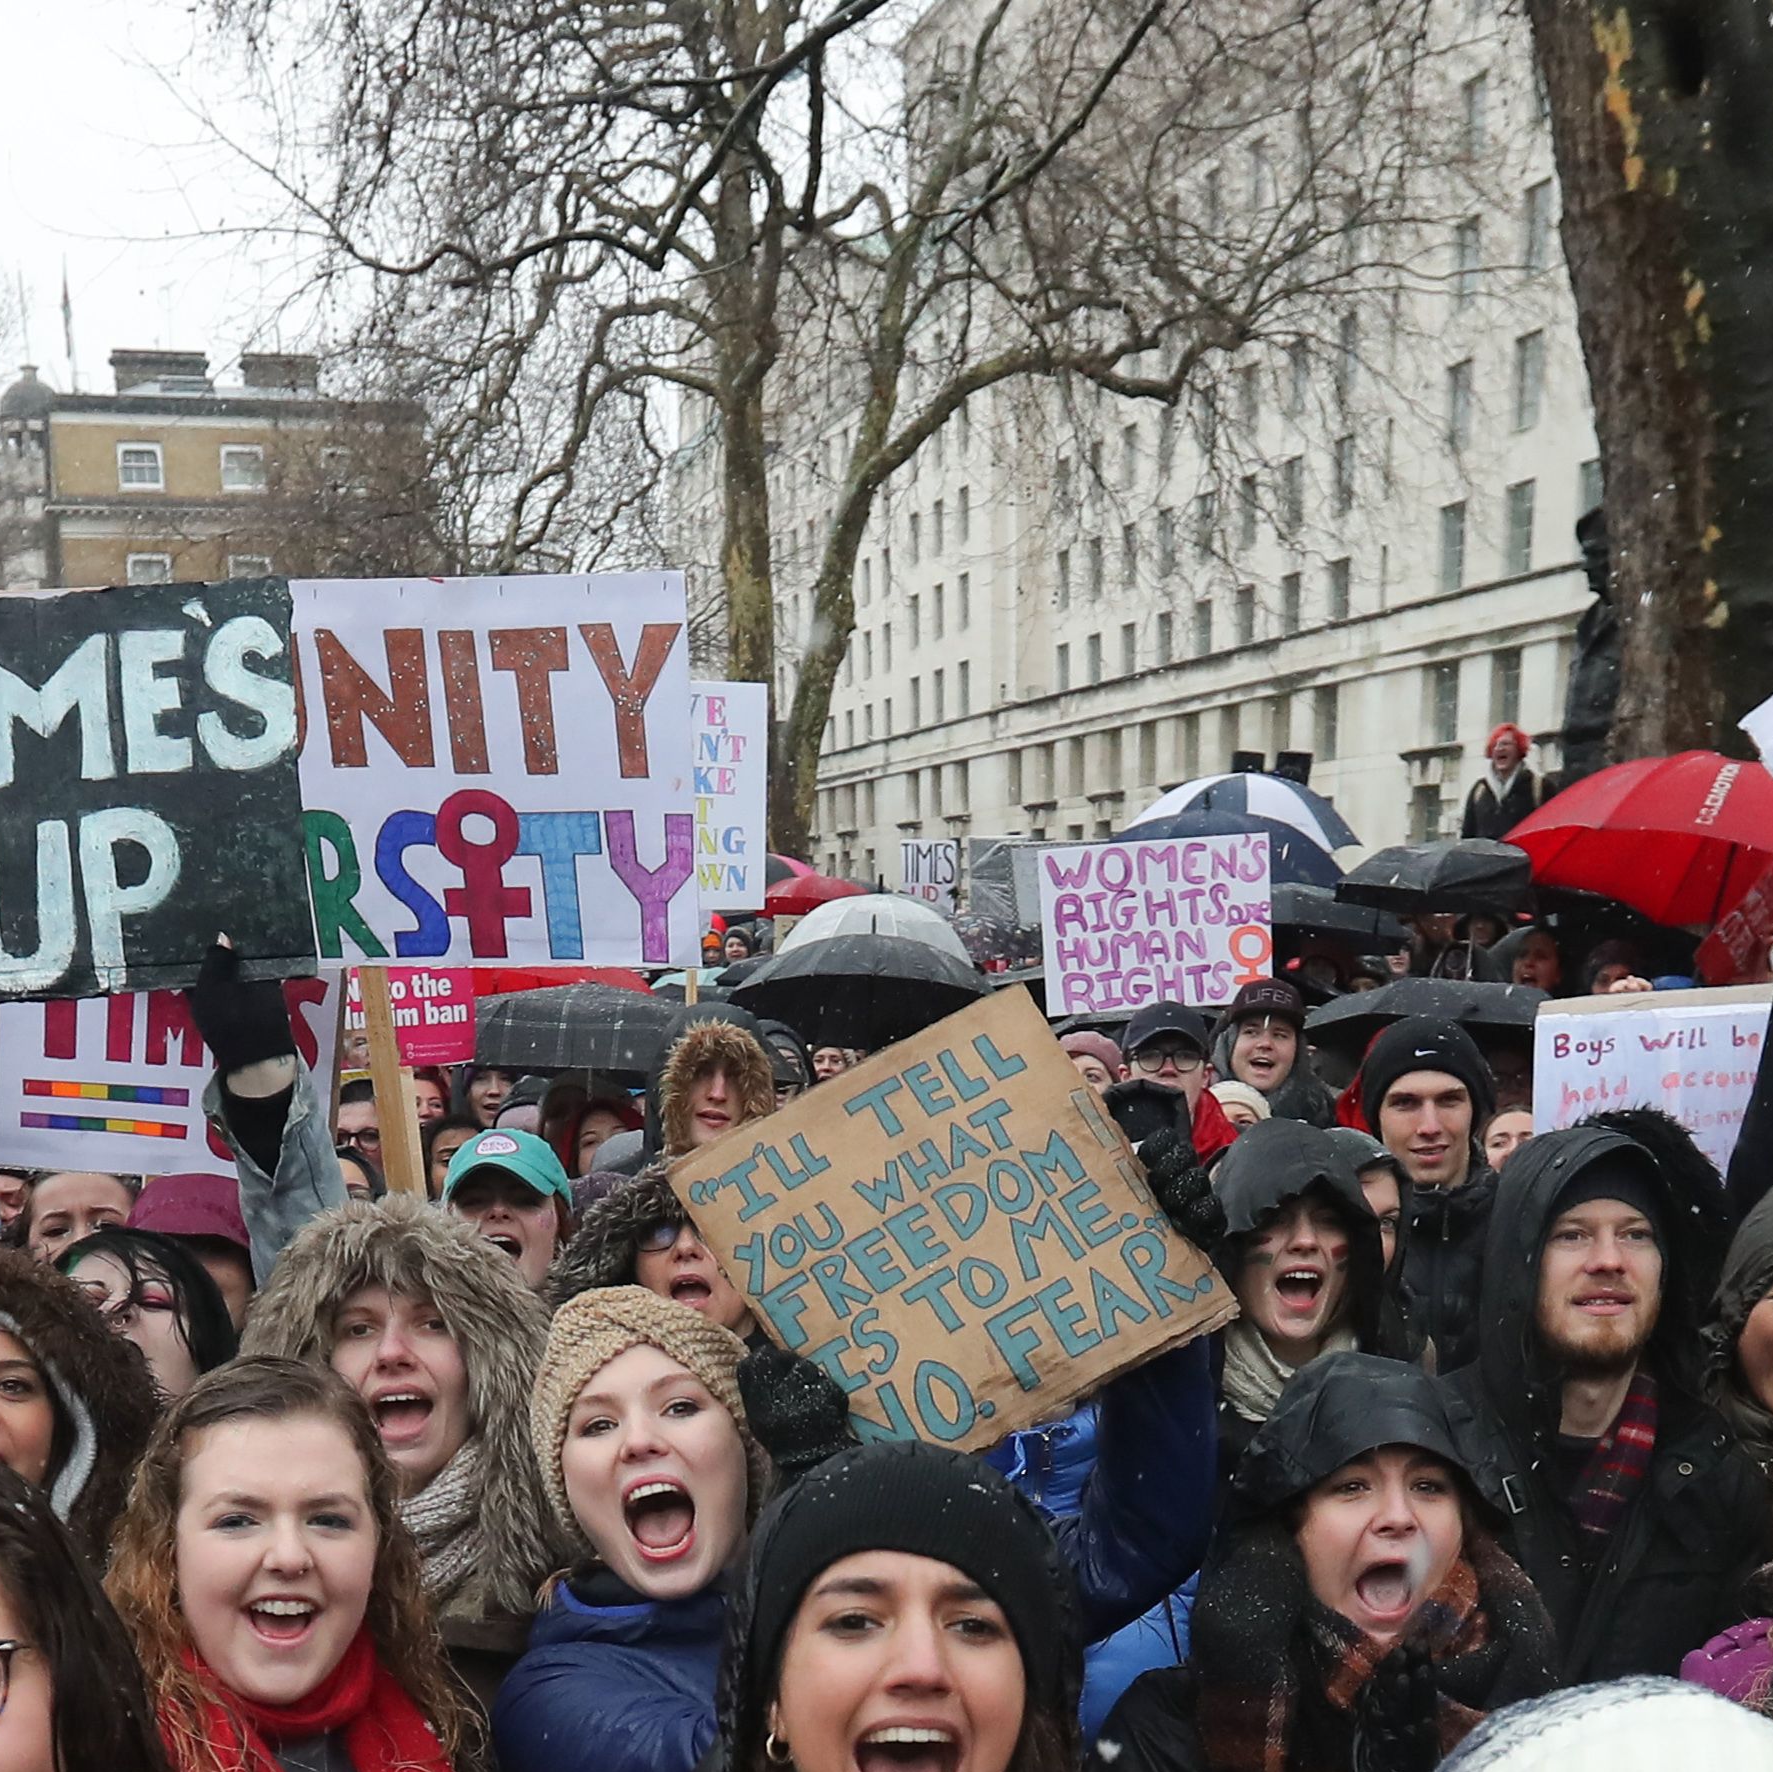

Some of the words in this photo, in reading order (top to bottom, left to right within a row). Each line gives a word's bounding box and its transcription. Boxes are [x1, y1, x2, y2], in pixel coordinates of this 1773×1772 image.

[291, 622, 683, 779] NITY
[901, 842, 956, 885] TIMES
[1044, 834, 1267, 892] WOMEN'S
[1054, 883, 1229, 937] RIGHTS
[1057, 927, 1207, 971] HUMAN
[411, 971, 452, 999] the
[424, 1001, 468, 1025] ban
[1062, 961, 1232, 1013] RIGHTS
[1554, 1033, 1616, 1066] Boys
[842, 1033, 1027, 1138] TELL
[734, 1202, 844, 1295] YOU
[852, 1098, 1013, 1215] WHAT
[757, 1129, 1088, 1350] FREEDOM
[805, 1308, 900, 1394] IS
[900, 1256, 1008, 1334] TO
[849, 1359, 996, 1444] NO.
[983, 1231, 1214, 1392] FEAR.
